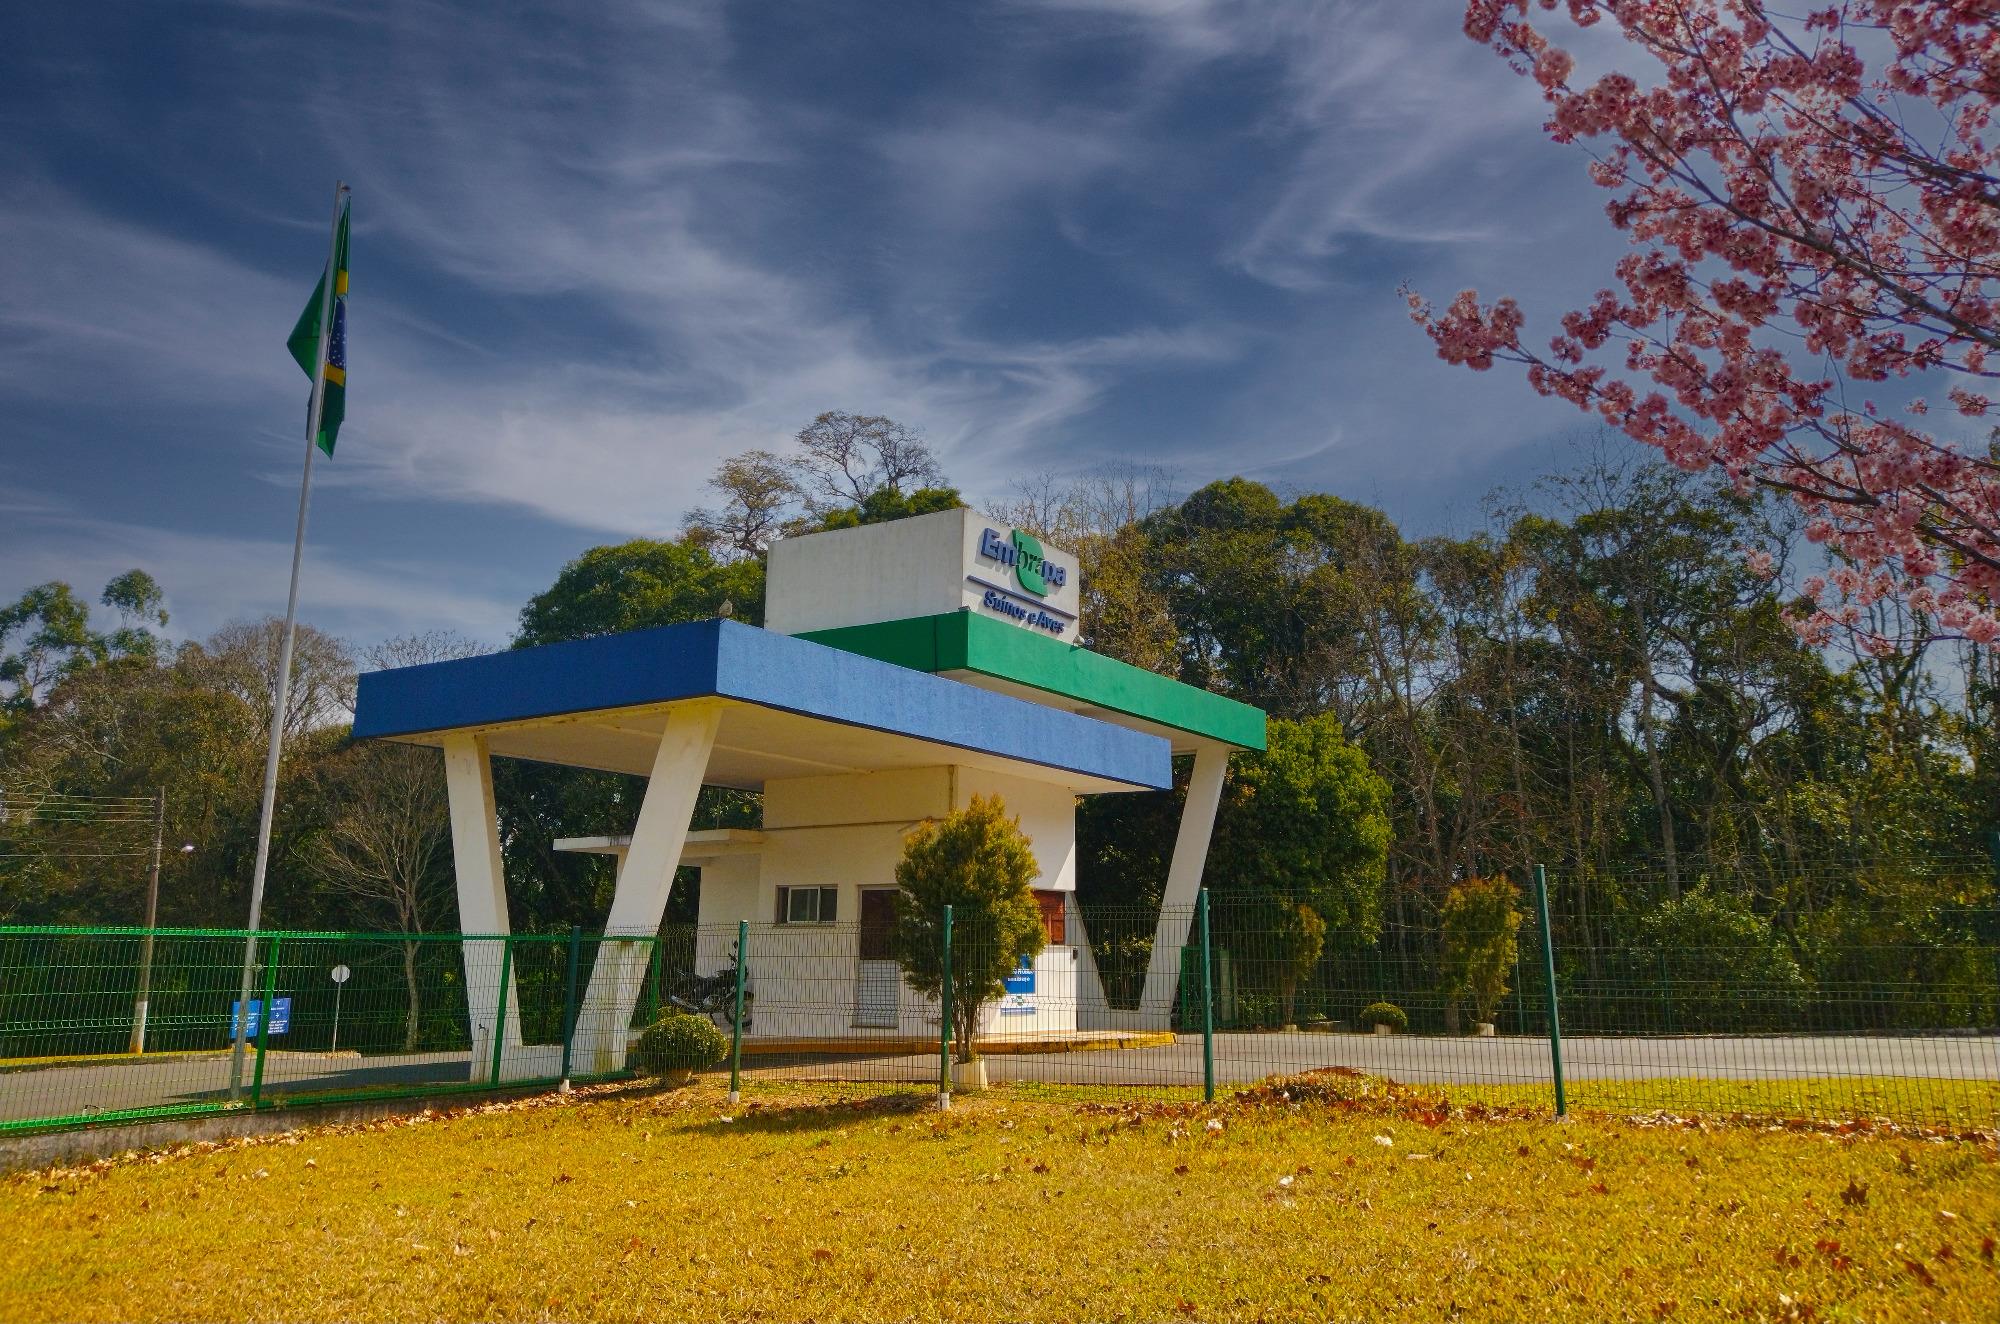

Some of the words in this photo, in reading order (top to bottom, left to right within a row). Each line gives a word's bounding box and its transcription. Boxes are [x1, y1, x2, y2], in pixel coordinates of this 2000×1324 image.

[981, 528, 1066, 587] Embrapa
[984, 591, 1027, 620] Suínos
[1027, 611, 1037, 625] e
[1036, 612, 1065, 633] Aves
